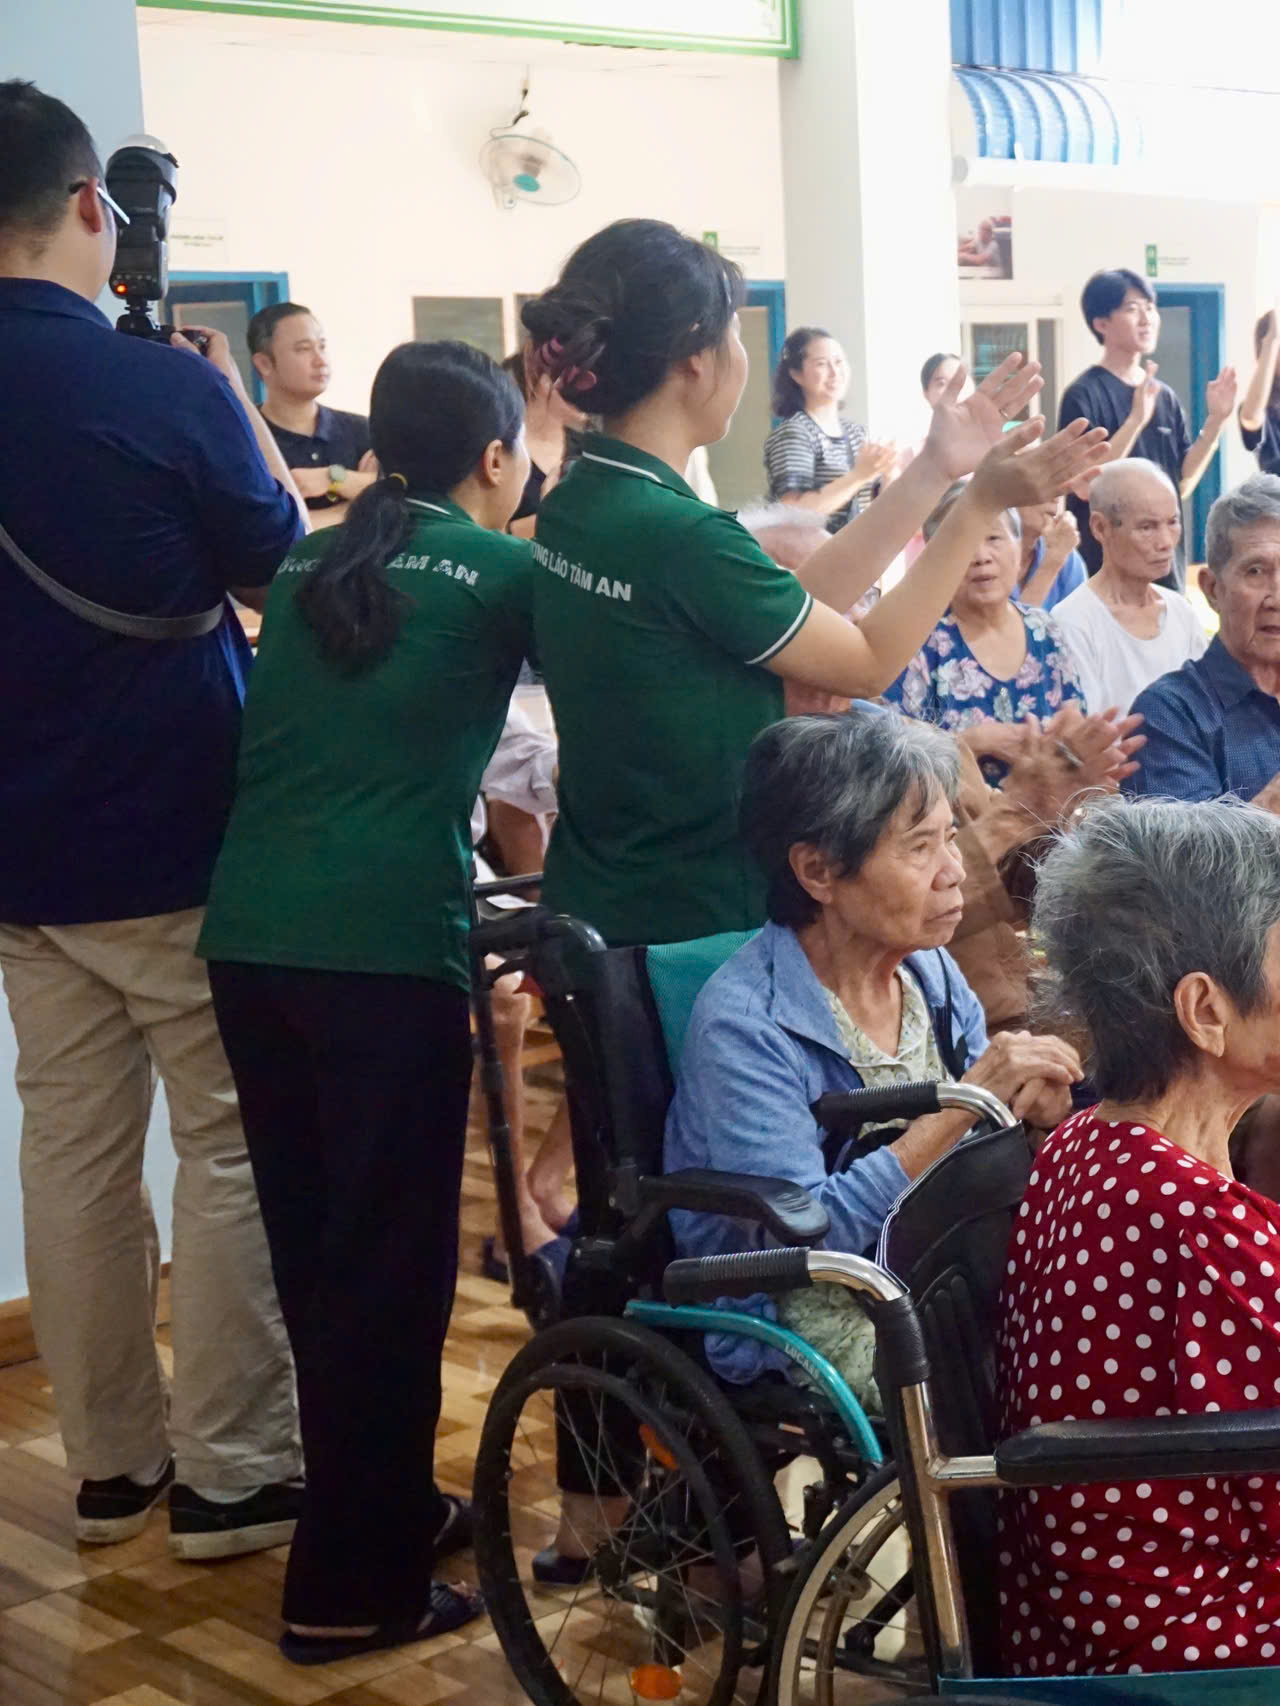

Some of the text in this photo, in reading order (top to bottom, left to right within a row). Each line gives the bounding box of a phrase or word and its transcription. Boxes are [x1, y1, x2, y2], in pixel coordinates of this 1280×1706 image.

[386, 552, 430, 571] ÂM
[432, 558, 480, 586] AN
[594, 576, 633, 602] AN
